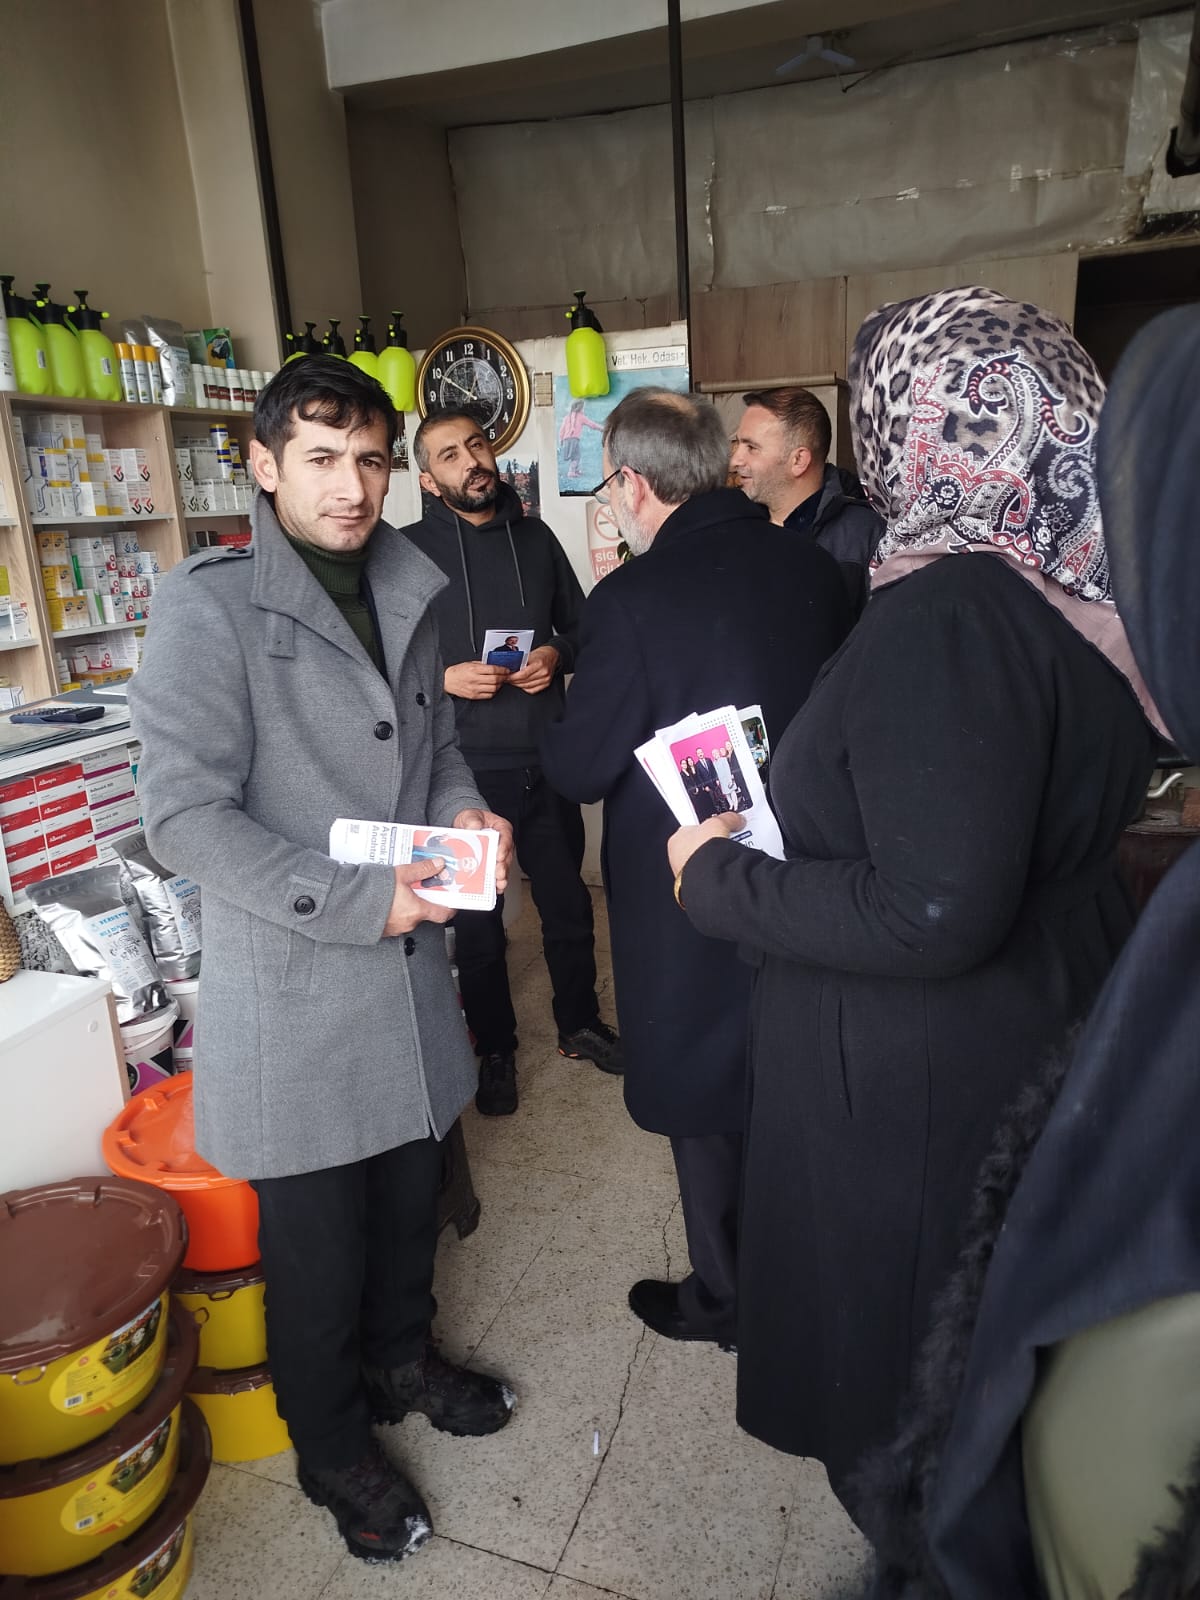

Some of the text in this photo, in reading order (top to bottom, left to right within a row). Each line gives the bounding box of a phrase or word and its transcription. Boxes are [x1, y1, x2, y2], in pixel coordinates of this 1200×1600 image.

[463, 343, 474, 355] 12
[486, 349, 490, 360] 1
[446, 350, 454, 362] 11
[432, 367, 442, 379] 10
[500, 365, 507, 377] 2
[429, 390, 437, 402] 9
[506, 388, 513, 400] 3
[502, 411, 509, 423] 4
[489, 428, 496, 439] 5
[368, 825, 380, 861] Anahtar
[380, 825, 390, 856] Aşmak
